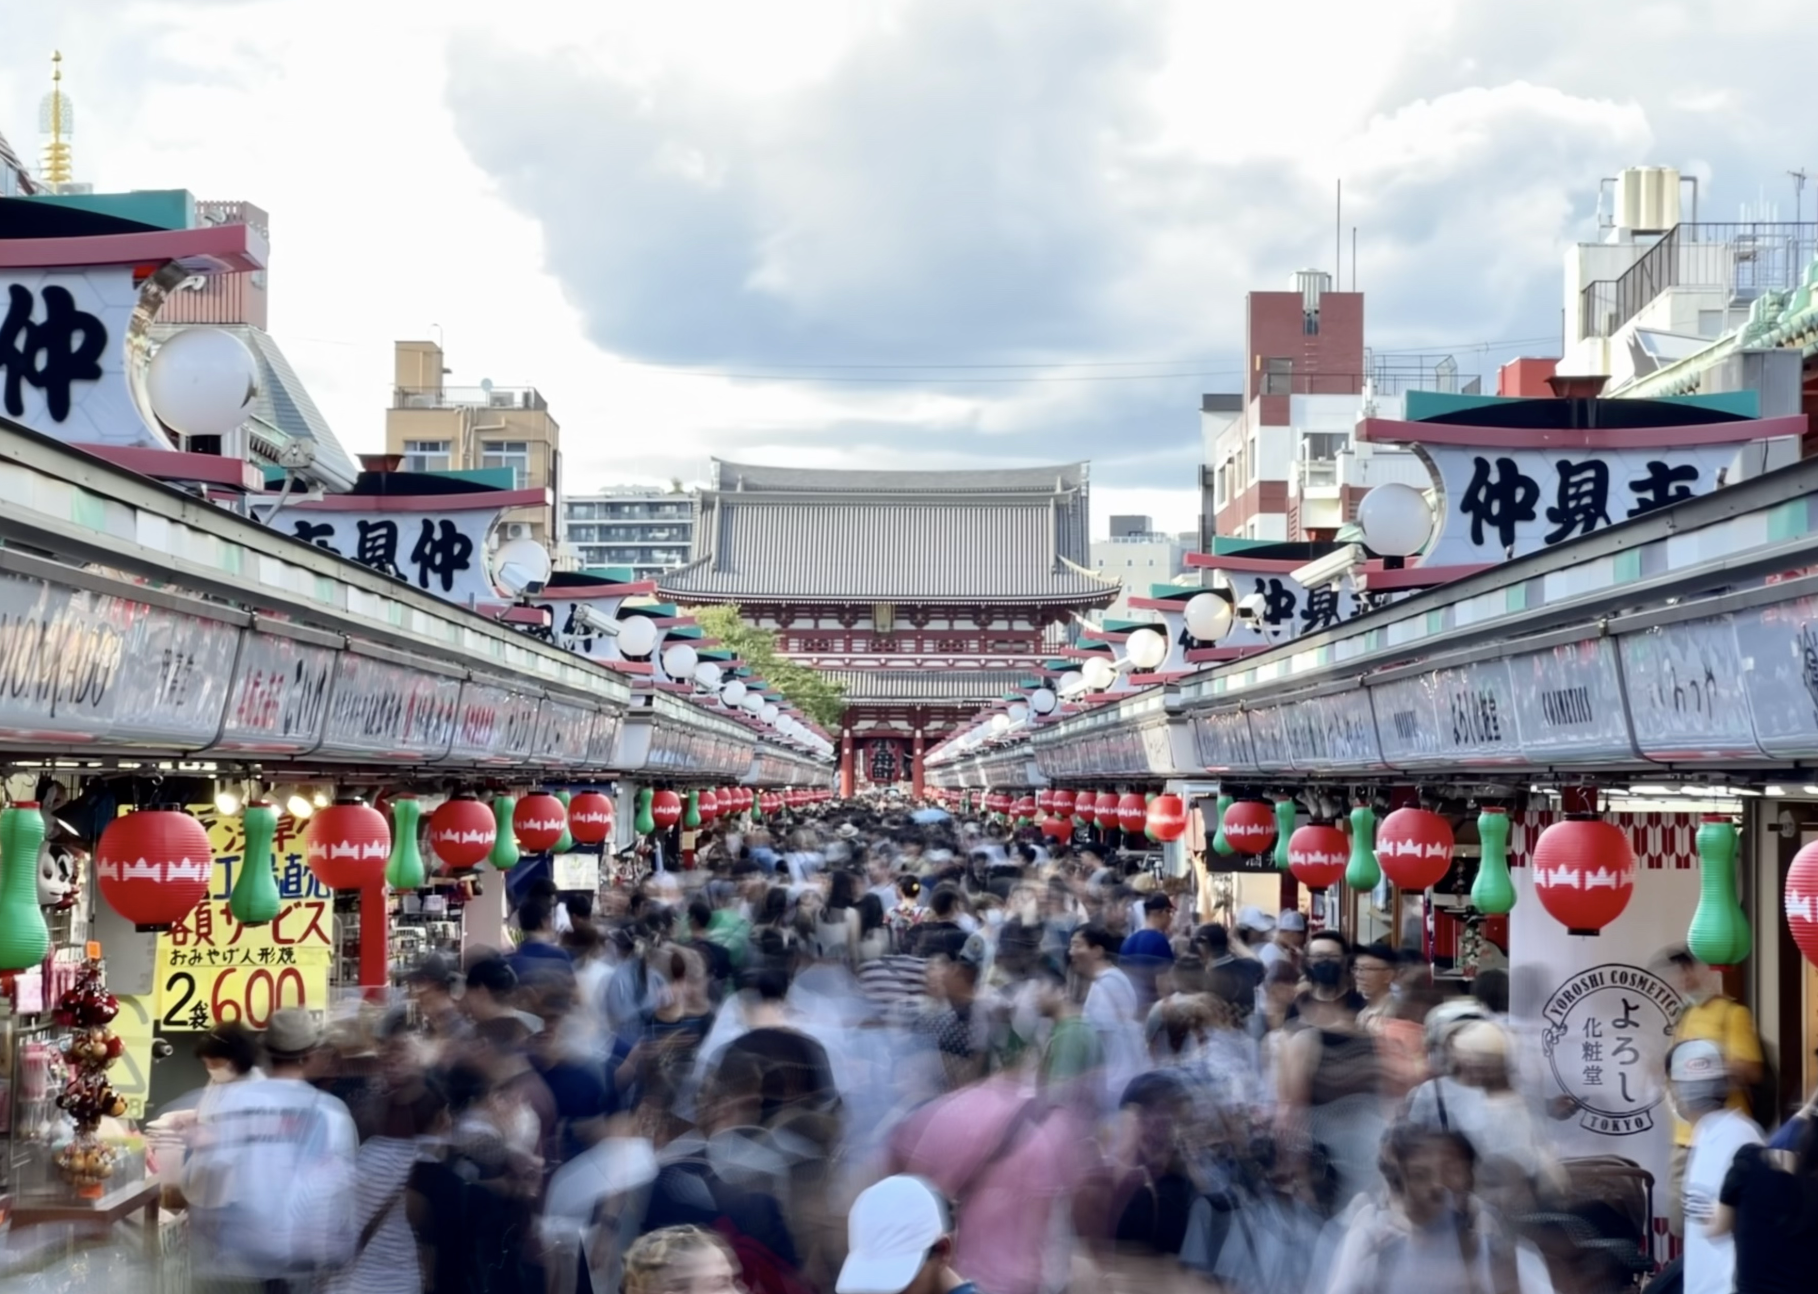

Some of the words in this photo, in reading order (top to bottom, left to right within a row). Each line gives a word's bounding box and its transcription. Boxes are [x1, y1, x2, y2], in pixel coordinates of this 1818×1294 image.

[0, 283, 109, 424] 仲
[1542, 685, 1593, 727] COSMETICS
[1550, 971, 1605, 1017] YOROSHI
[1610, 970, 1681, 1018] COSMETICS
[1581, 1016, 1604, 1086] 化粧堂
[1611, 997, 1640, 1103] よろし
[1589, 1116, 1644, 1132] TOKYO
